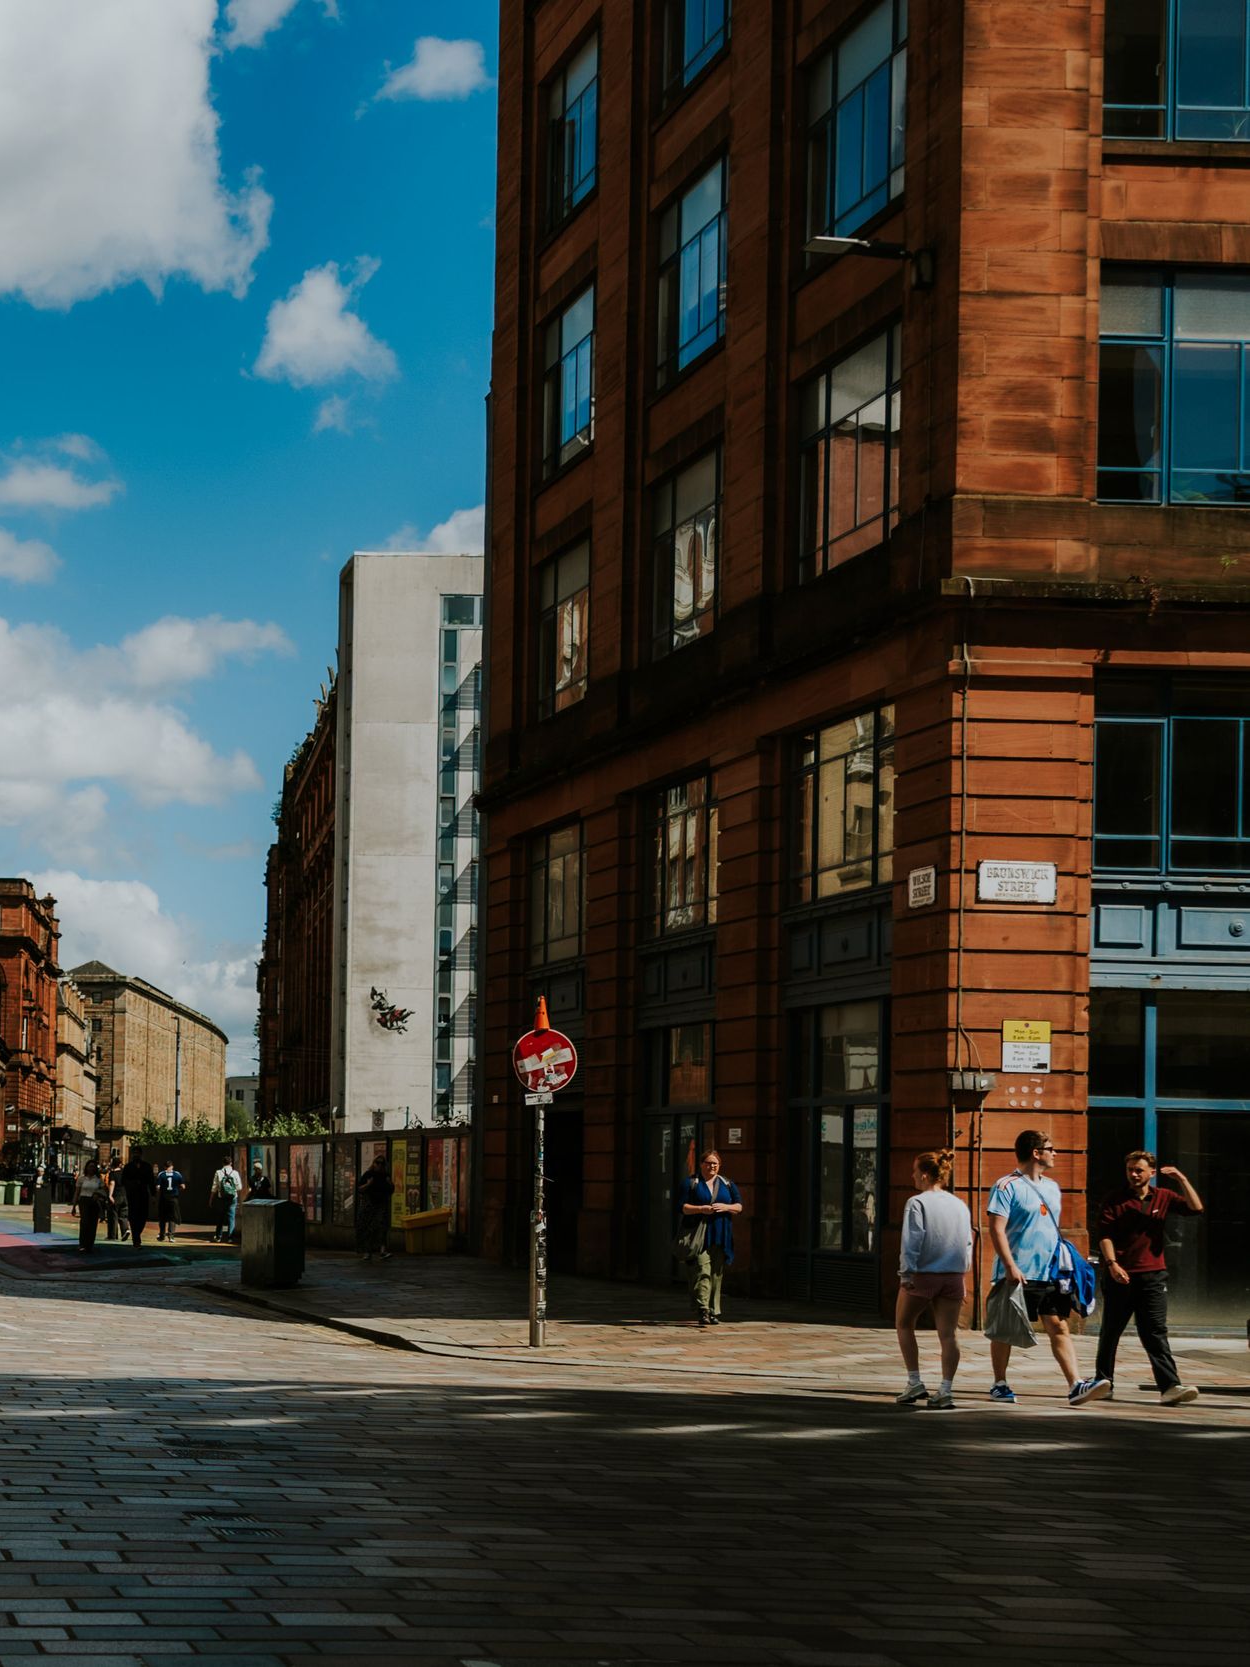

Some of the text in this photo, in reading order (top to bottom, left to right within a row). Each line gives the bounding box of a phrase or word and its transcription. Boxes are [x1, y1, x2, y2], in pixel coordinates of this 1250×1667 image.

[986, 867, 1049, 880] BRUNSWICK
[997, 880, 1038, 893] STREET
[166, 1177, 174, 1191] 1
